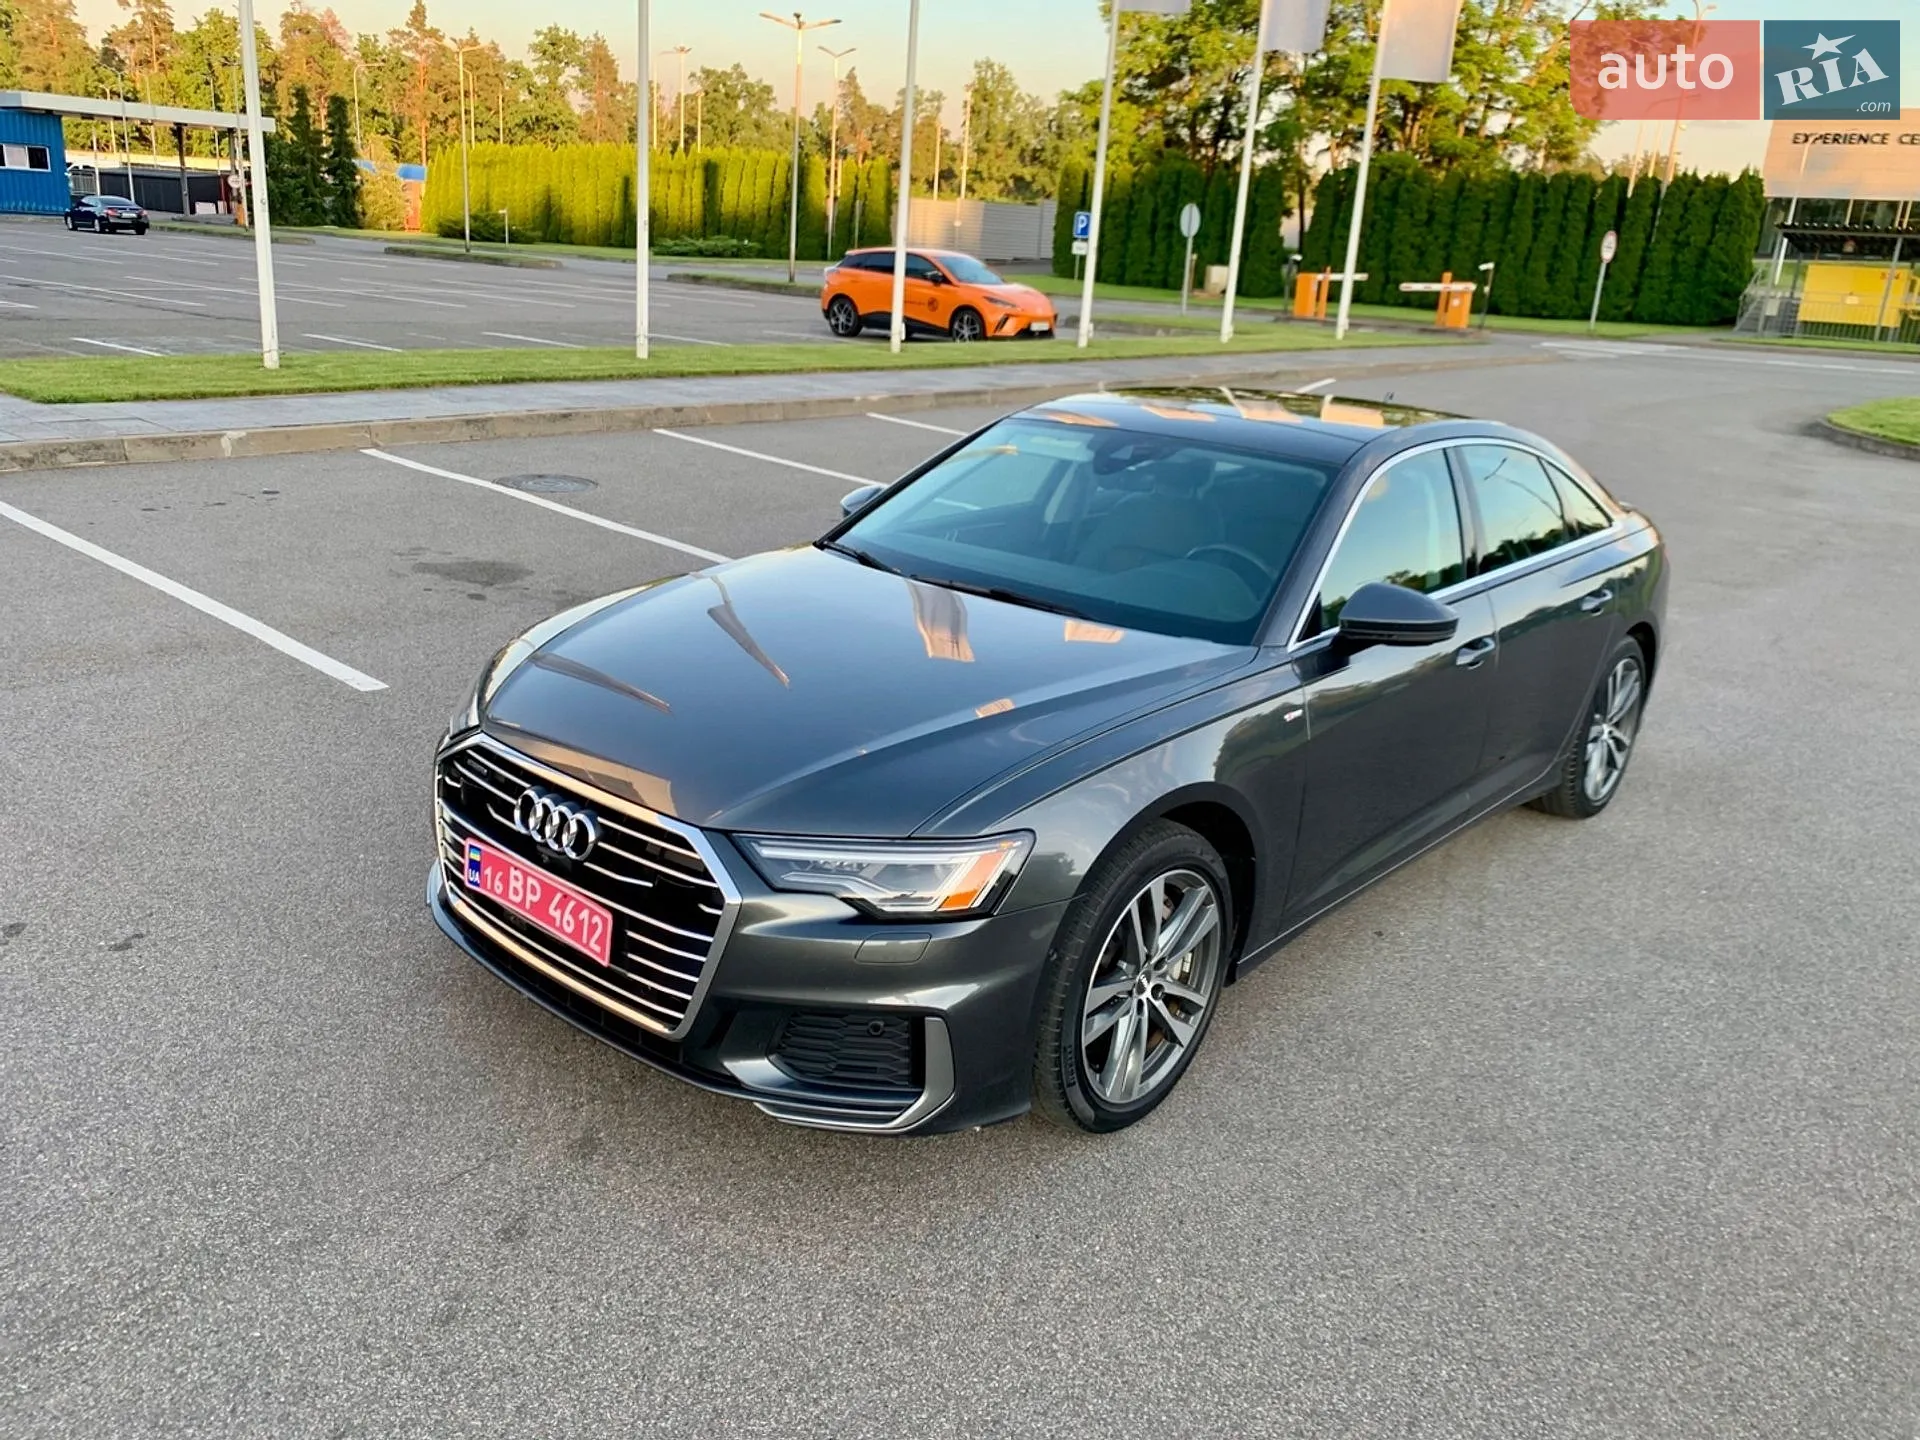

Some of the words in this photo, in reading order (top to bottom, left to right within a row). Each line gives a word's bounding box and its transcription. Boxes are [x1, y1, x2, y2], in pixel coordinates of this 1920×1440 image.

[1077, 215, 1087, 234] P
[469, 868, 480, 884] UA
[548, 892, 602, 953] 4612
